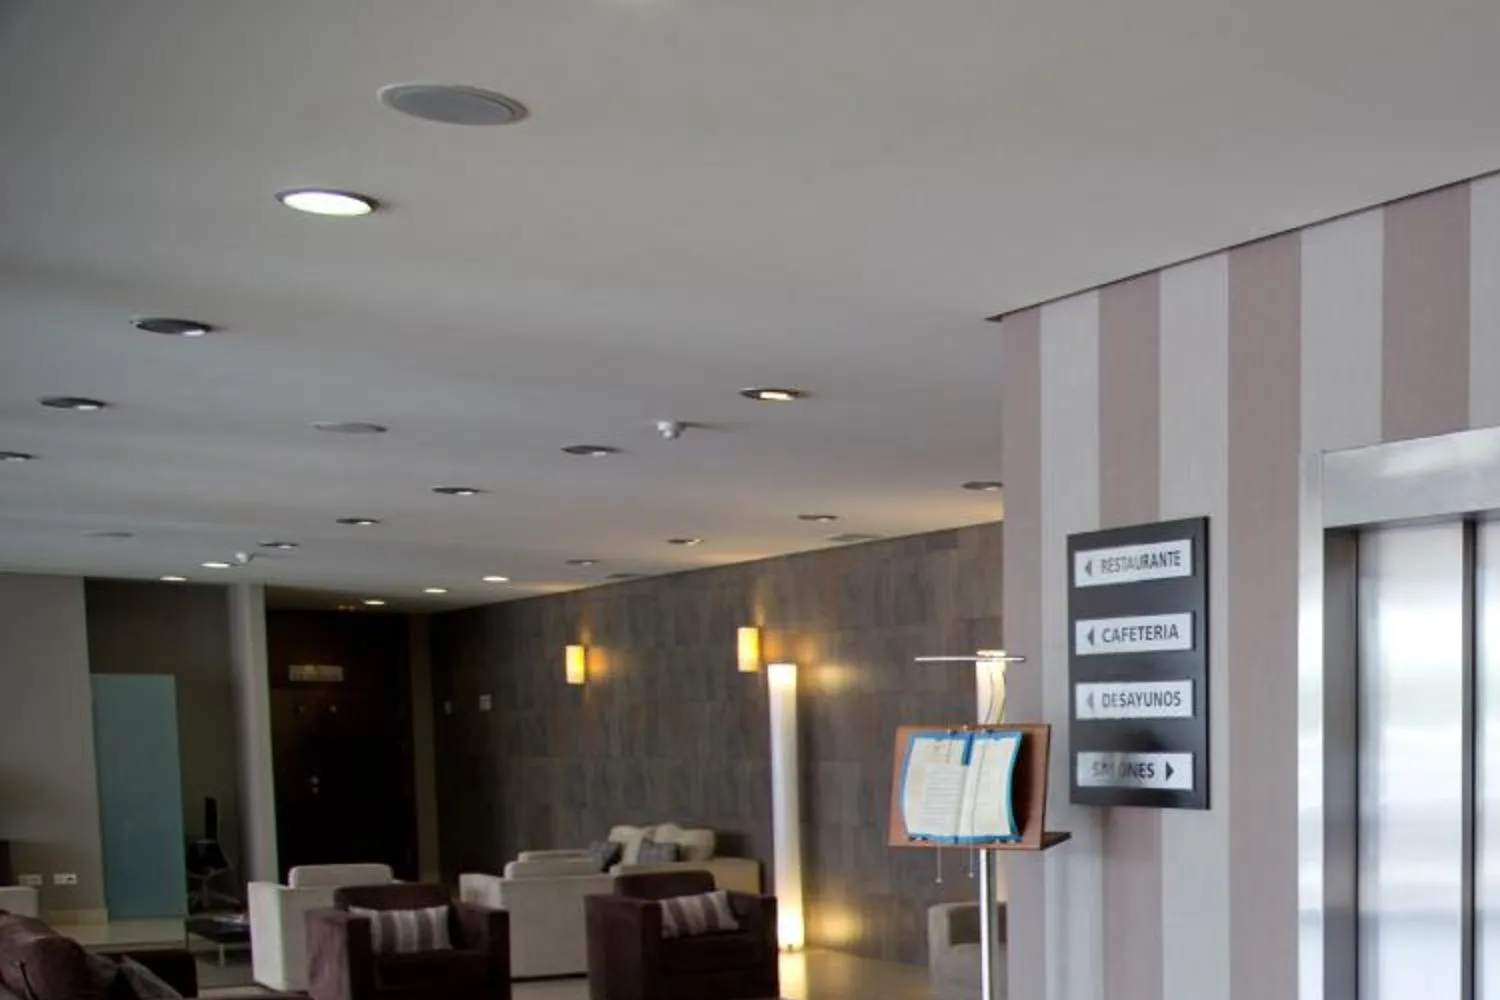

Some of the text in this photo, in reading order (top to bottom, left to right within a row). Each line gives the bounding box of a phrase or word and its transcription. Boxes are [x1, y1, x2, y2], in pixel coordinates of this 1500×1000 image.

[1101, 549, 1182, 573] RESTAURANTE
[1102, 623, 1179, 643] CAFETERIA
[1102, 690, 1181, 708] DESAYUNOS
